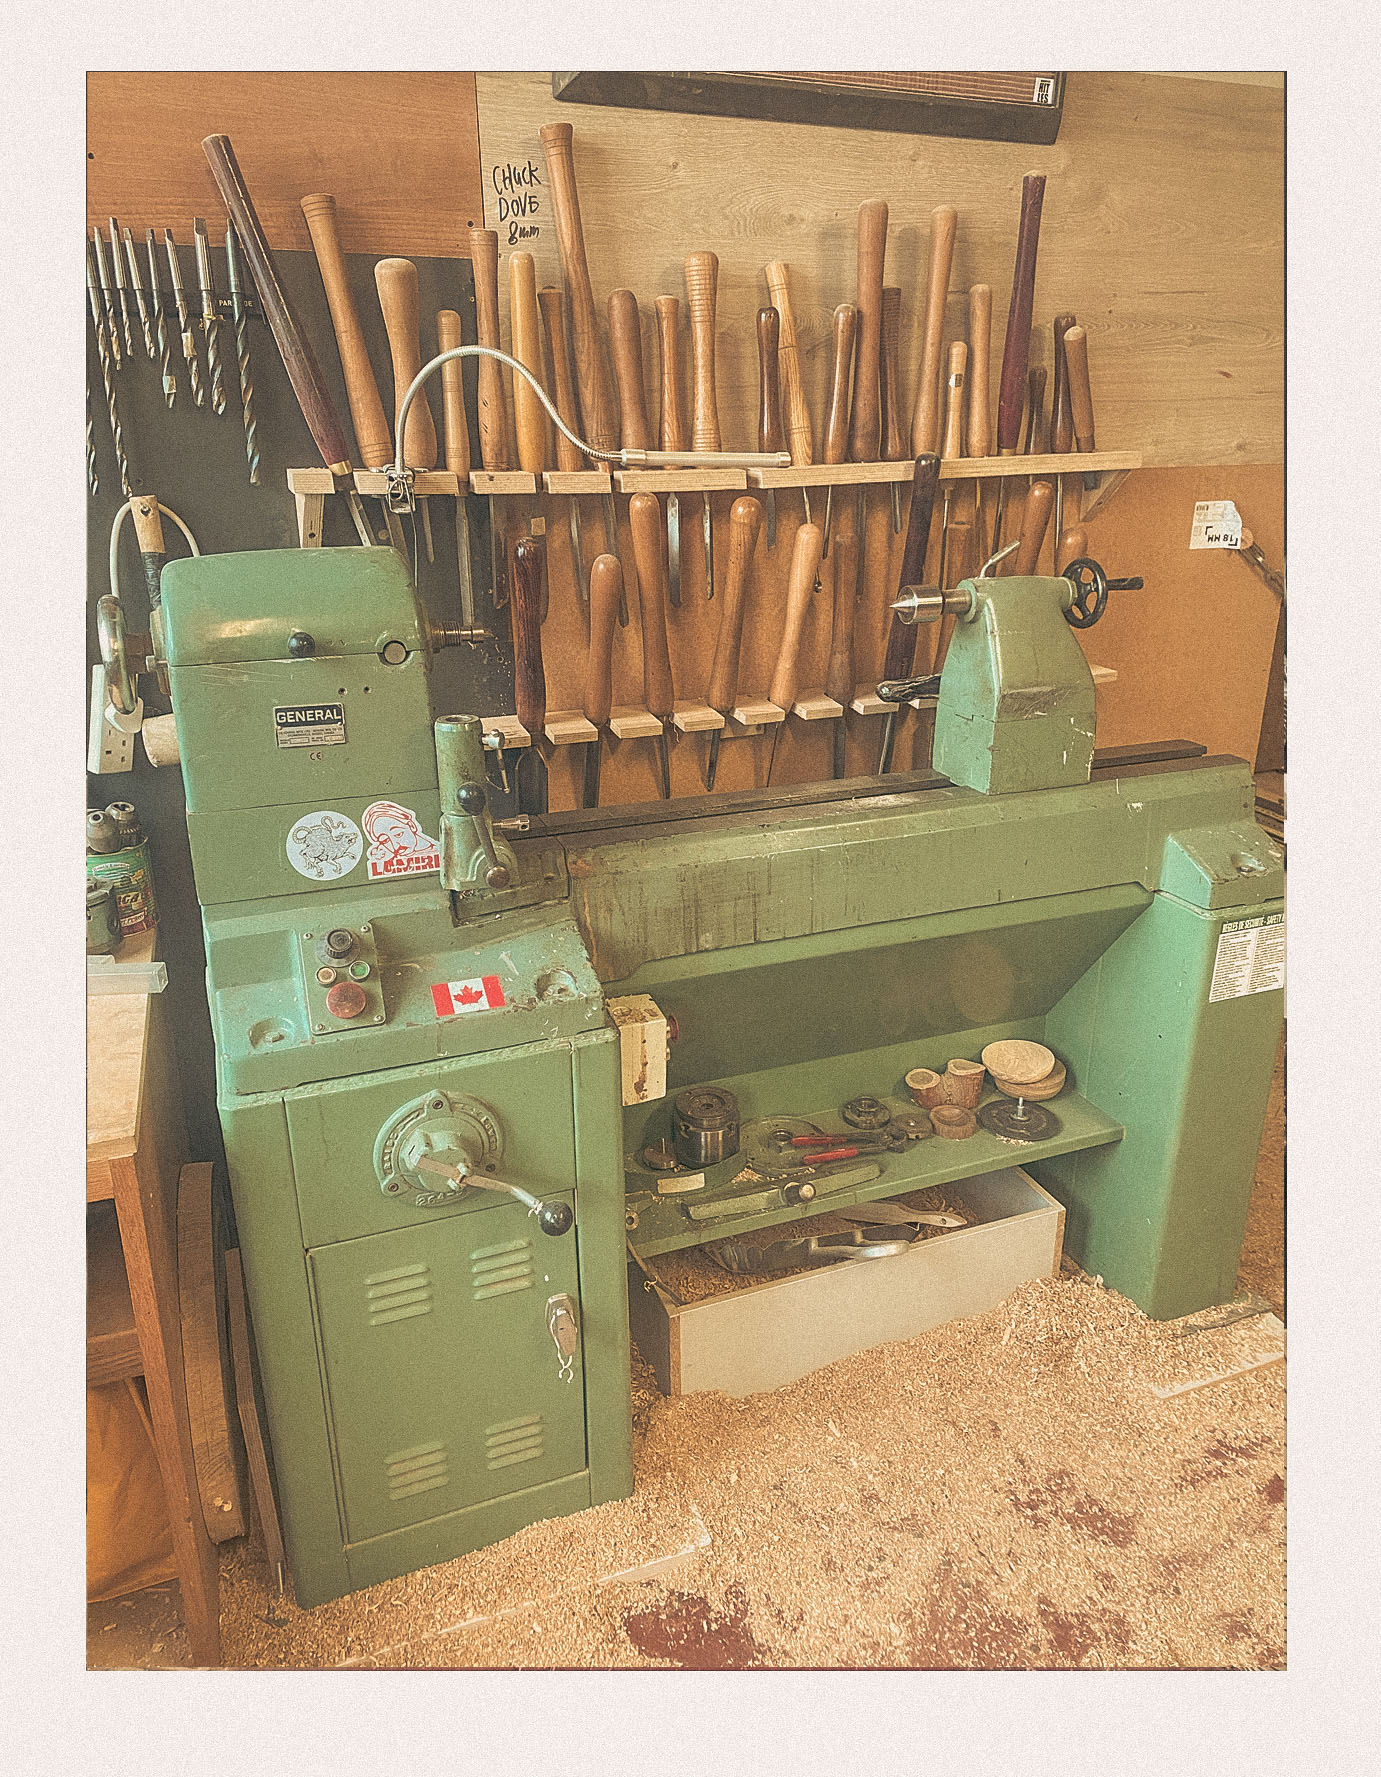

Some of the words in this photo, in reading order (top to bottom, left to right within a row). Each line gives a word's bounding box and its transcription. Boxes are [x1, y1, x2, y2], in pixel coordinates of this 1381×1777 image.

[499, 192, 539, 222] DOVE
[1223, 534, 1234, 542] 18
[276, 709, 341, 722] GENERAL
